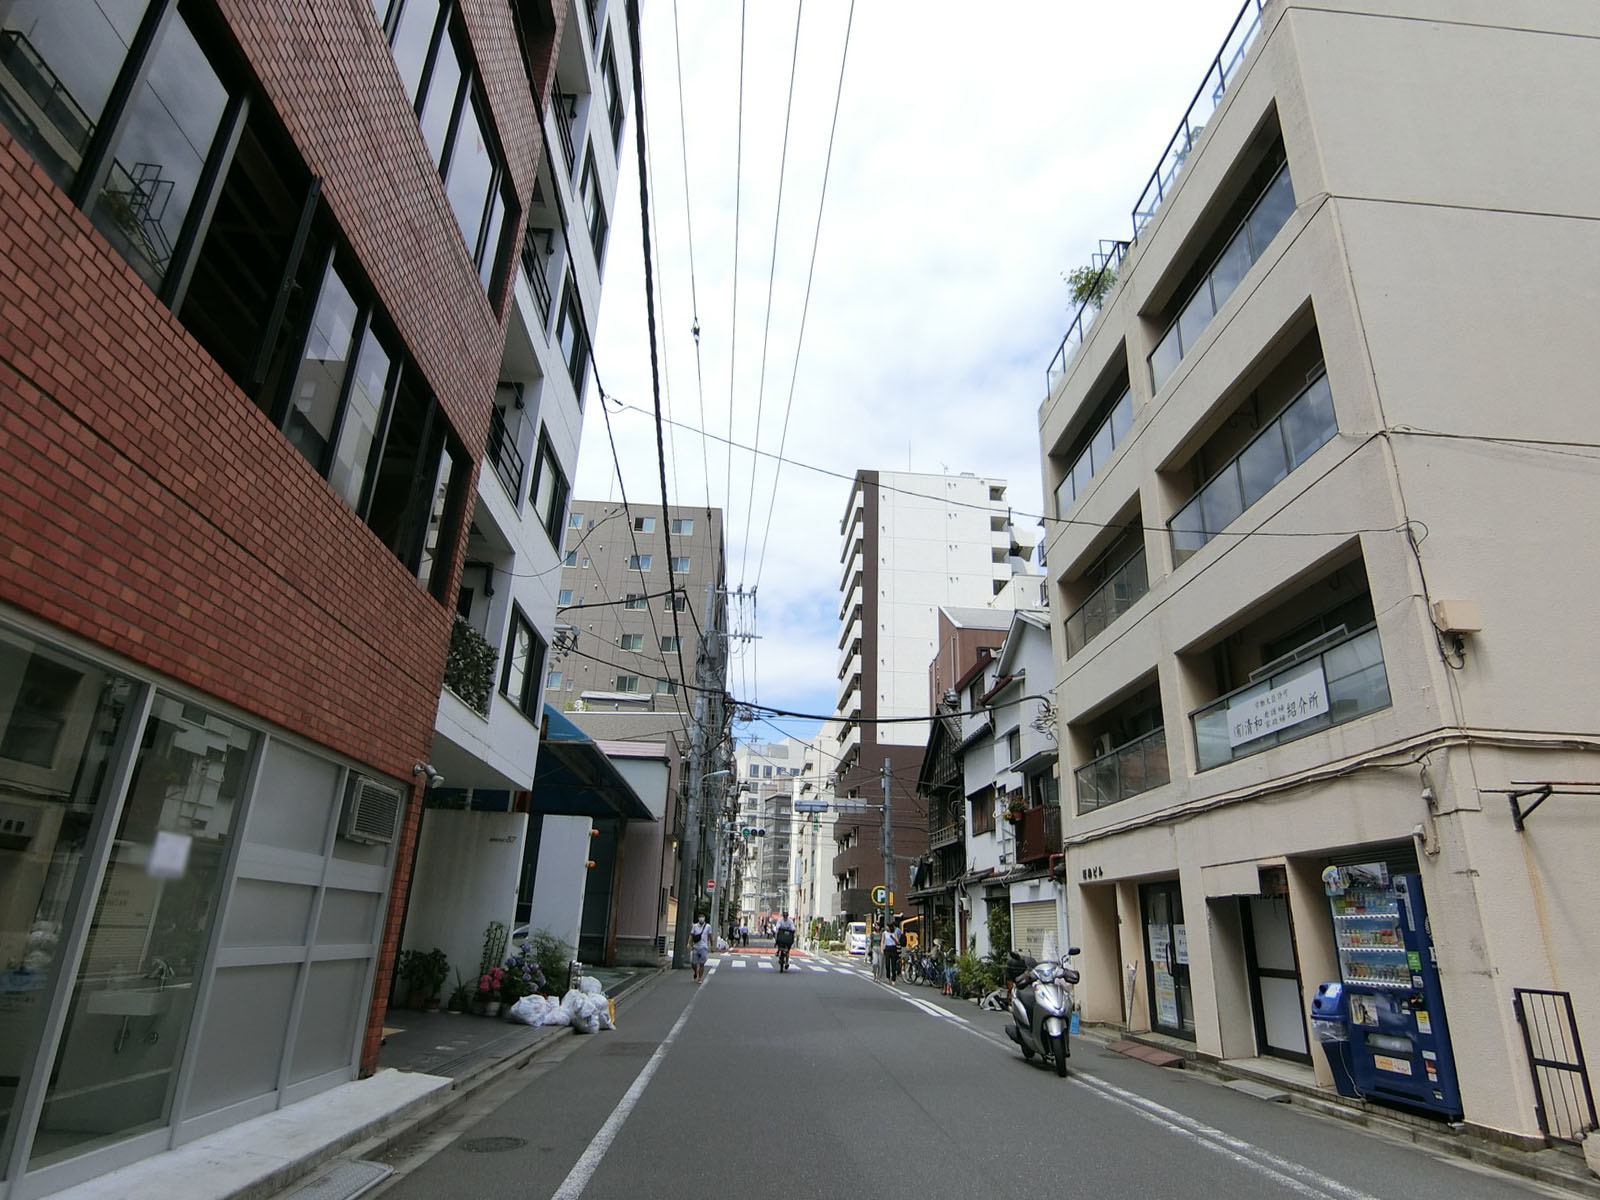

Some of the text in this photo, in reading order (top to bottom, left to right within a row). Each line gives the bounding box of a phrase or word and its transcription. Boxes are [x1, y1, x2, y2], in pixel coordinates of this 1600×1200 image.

[1287, 691, 1319, 718] 紹介所
[877, 889, 887, 902] P
